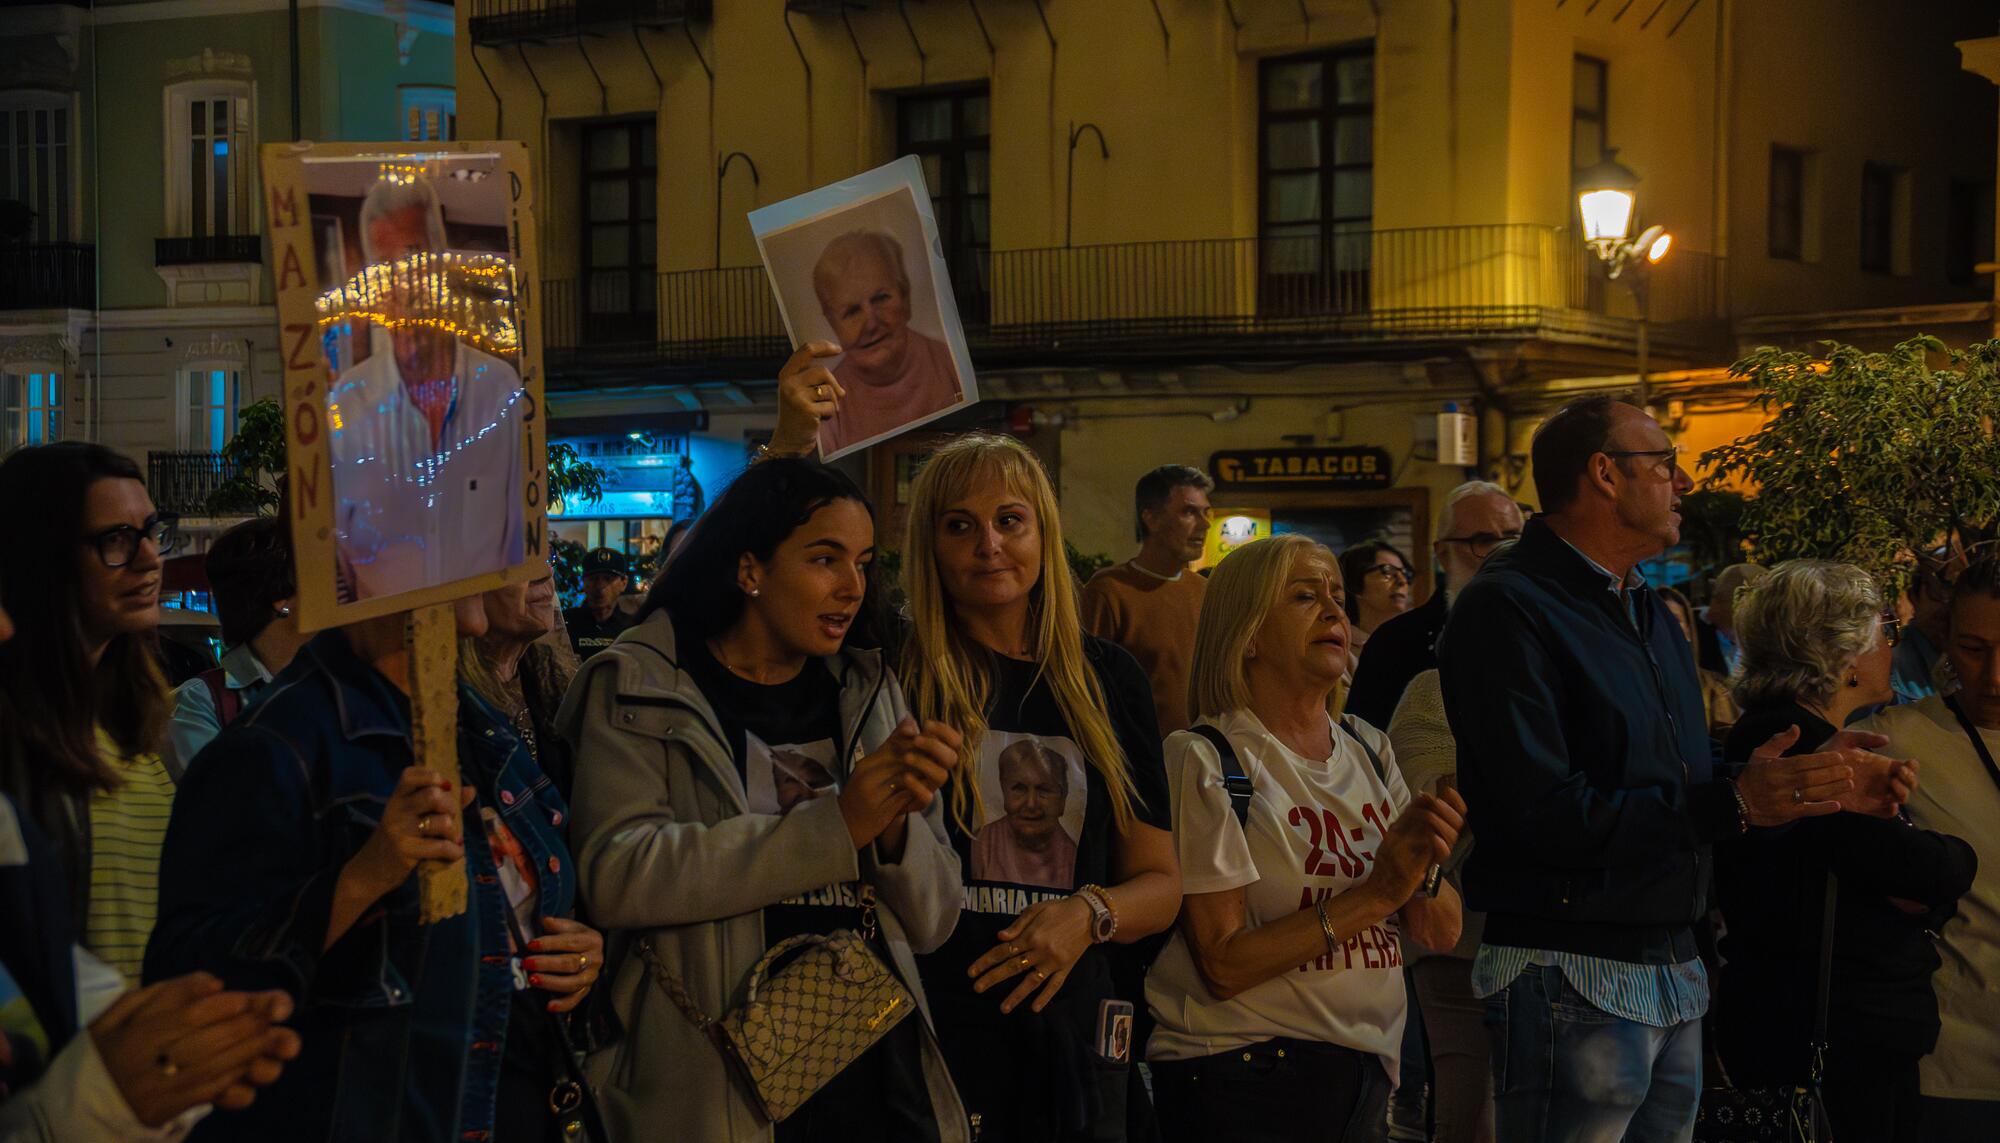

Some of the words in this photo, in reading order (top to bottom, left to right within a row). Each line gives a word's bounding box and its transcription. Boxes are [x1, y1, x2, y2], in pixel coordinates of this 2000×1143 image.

[272, 184, 320, 520] MAZÓN
[1253, 455, 1377, 474] TABACOS
[808, 882, 862, 909] LUIS
[961, 886, 1029, 915] MARIA
